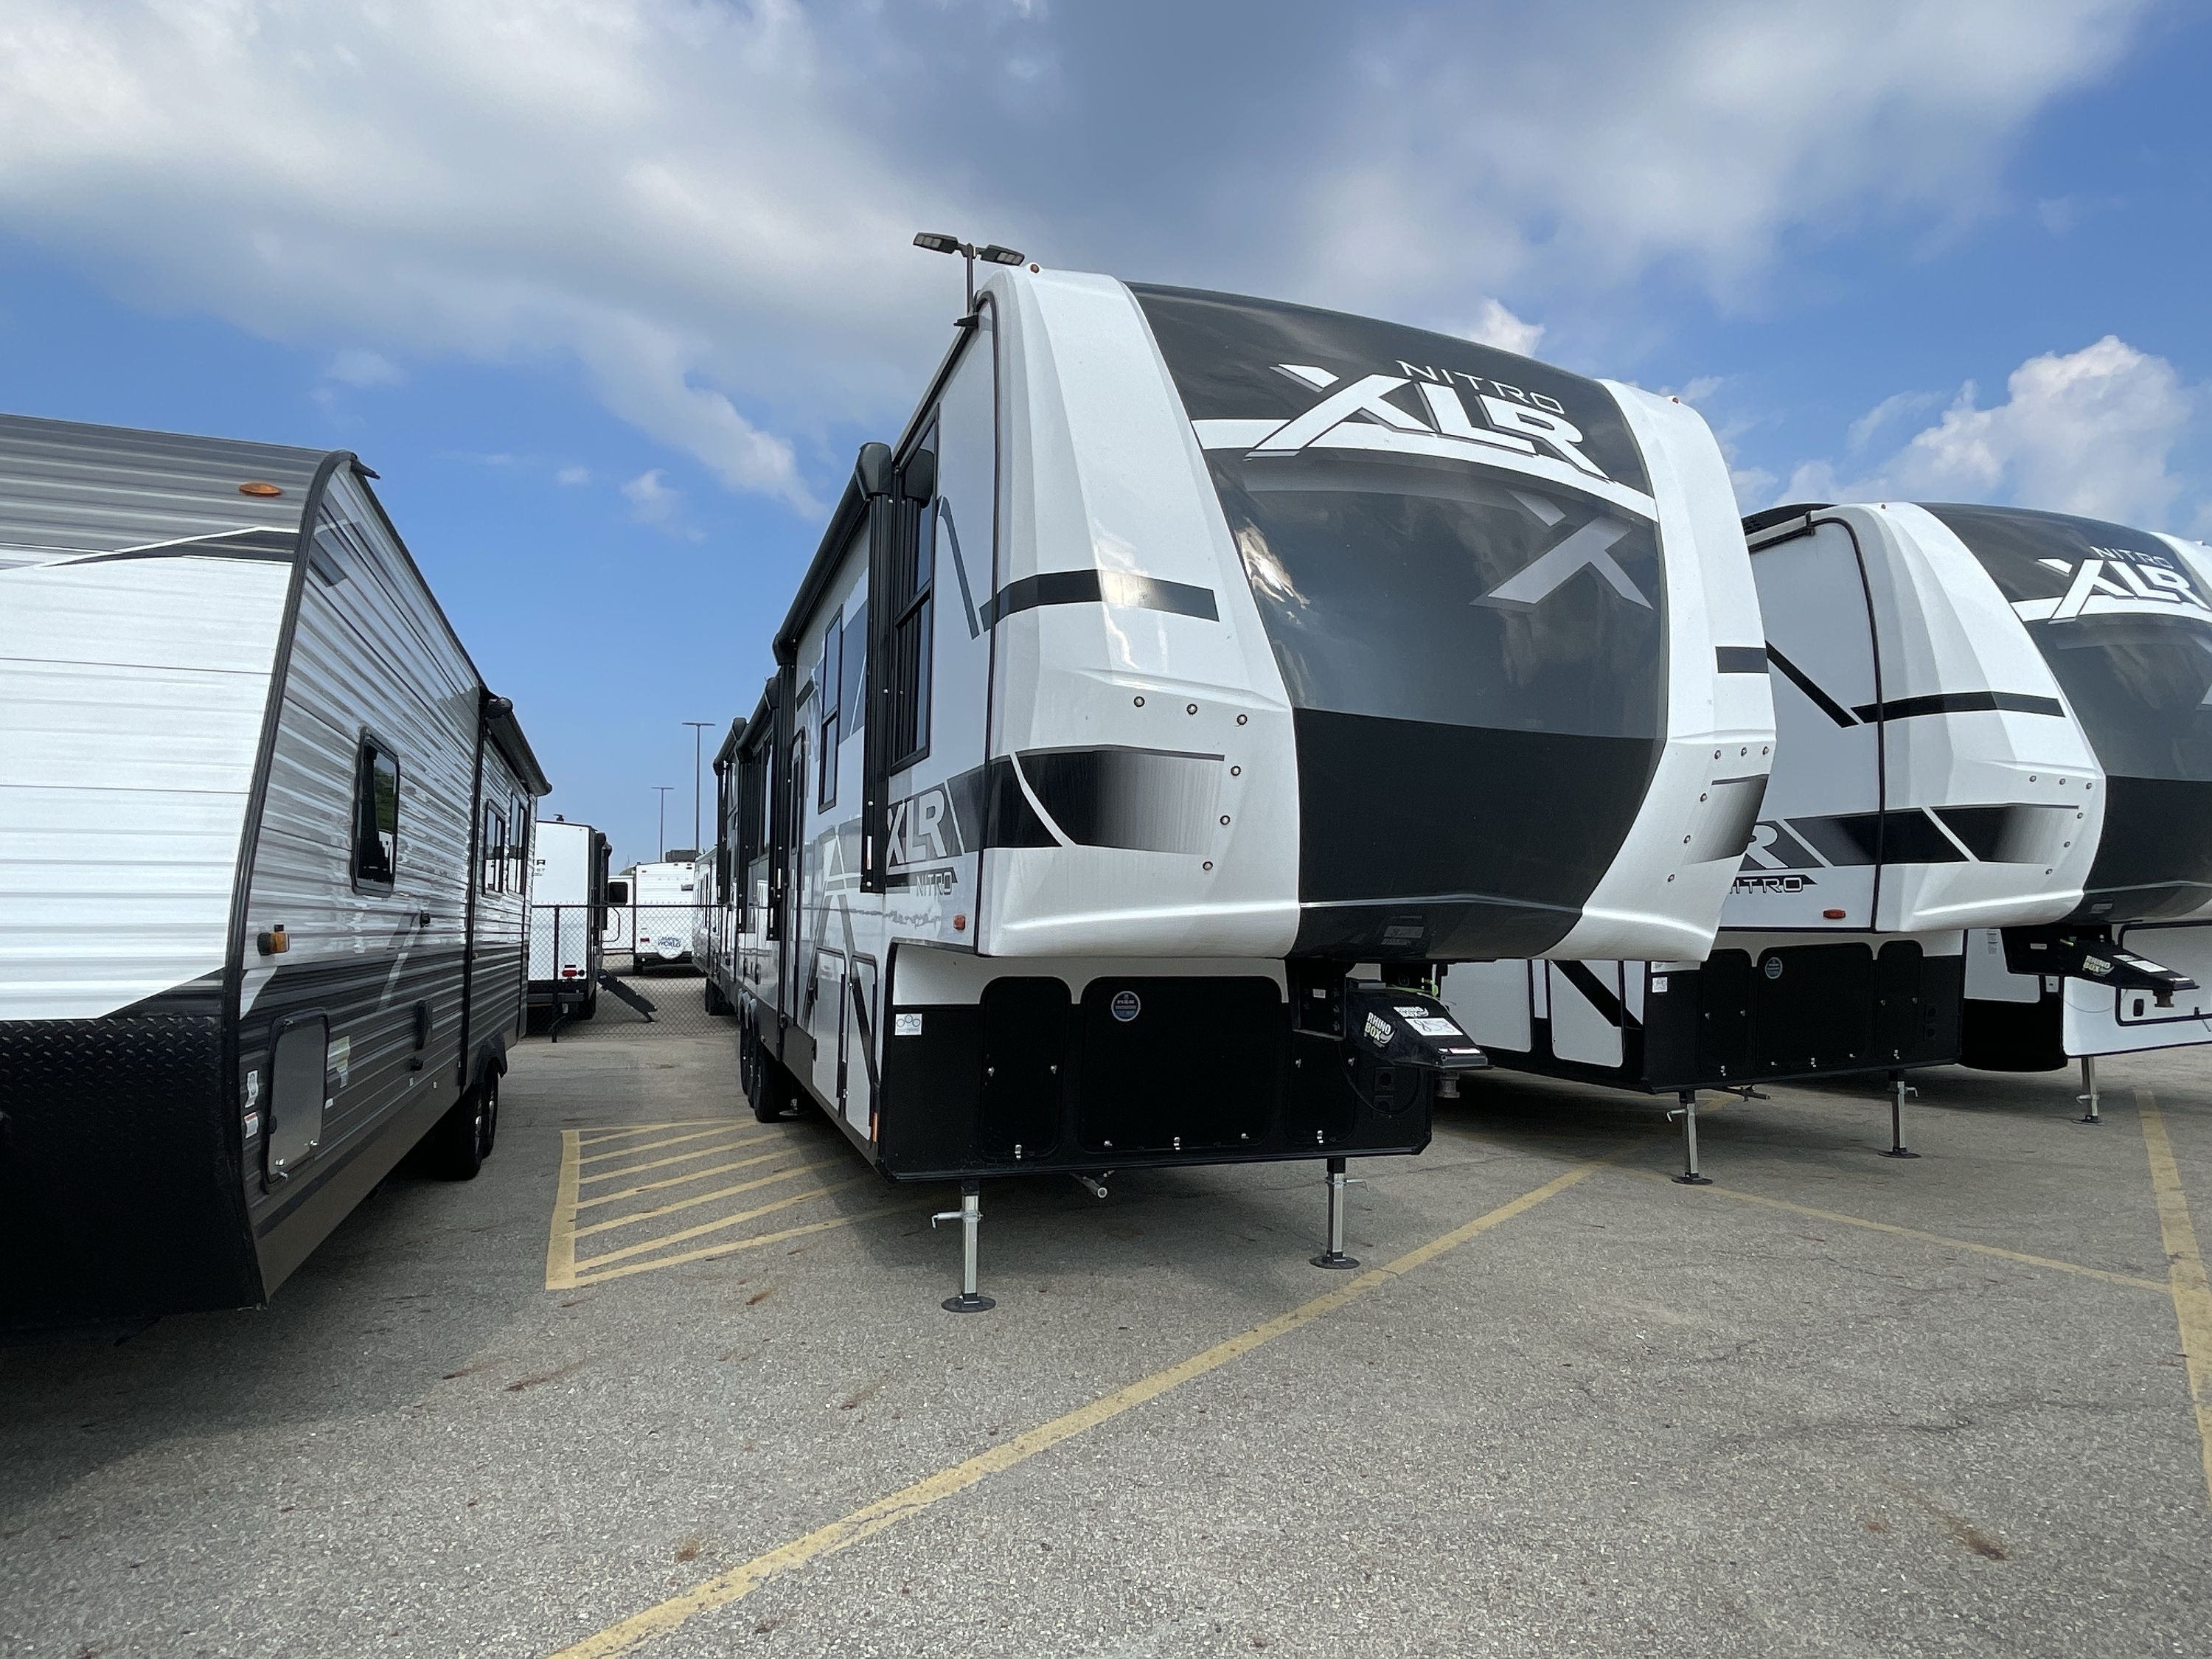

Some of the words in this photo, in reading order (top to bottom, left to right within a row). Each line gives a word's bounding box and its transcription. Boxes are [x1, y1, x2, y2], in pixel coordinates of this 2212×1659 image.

[1395, 360, 1565, 414] NITRO
[1244, 364, 1611, 484] XLR
[2090, 546, 2174, 569] NITRO
[2035, 558, 2212, 625] XLR
[886, 790, 947, 865] XLR
[917, 872, 953, 897] NITRO
[1730, 877, 1804, 894] ITRO
[1365, 1022, 1381, 1041] BOX
[1368, 1012, 1391, 1035] RHINO
